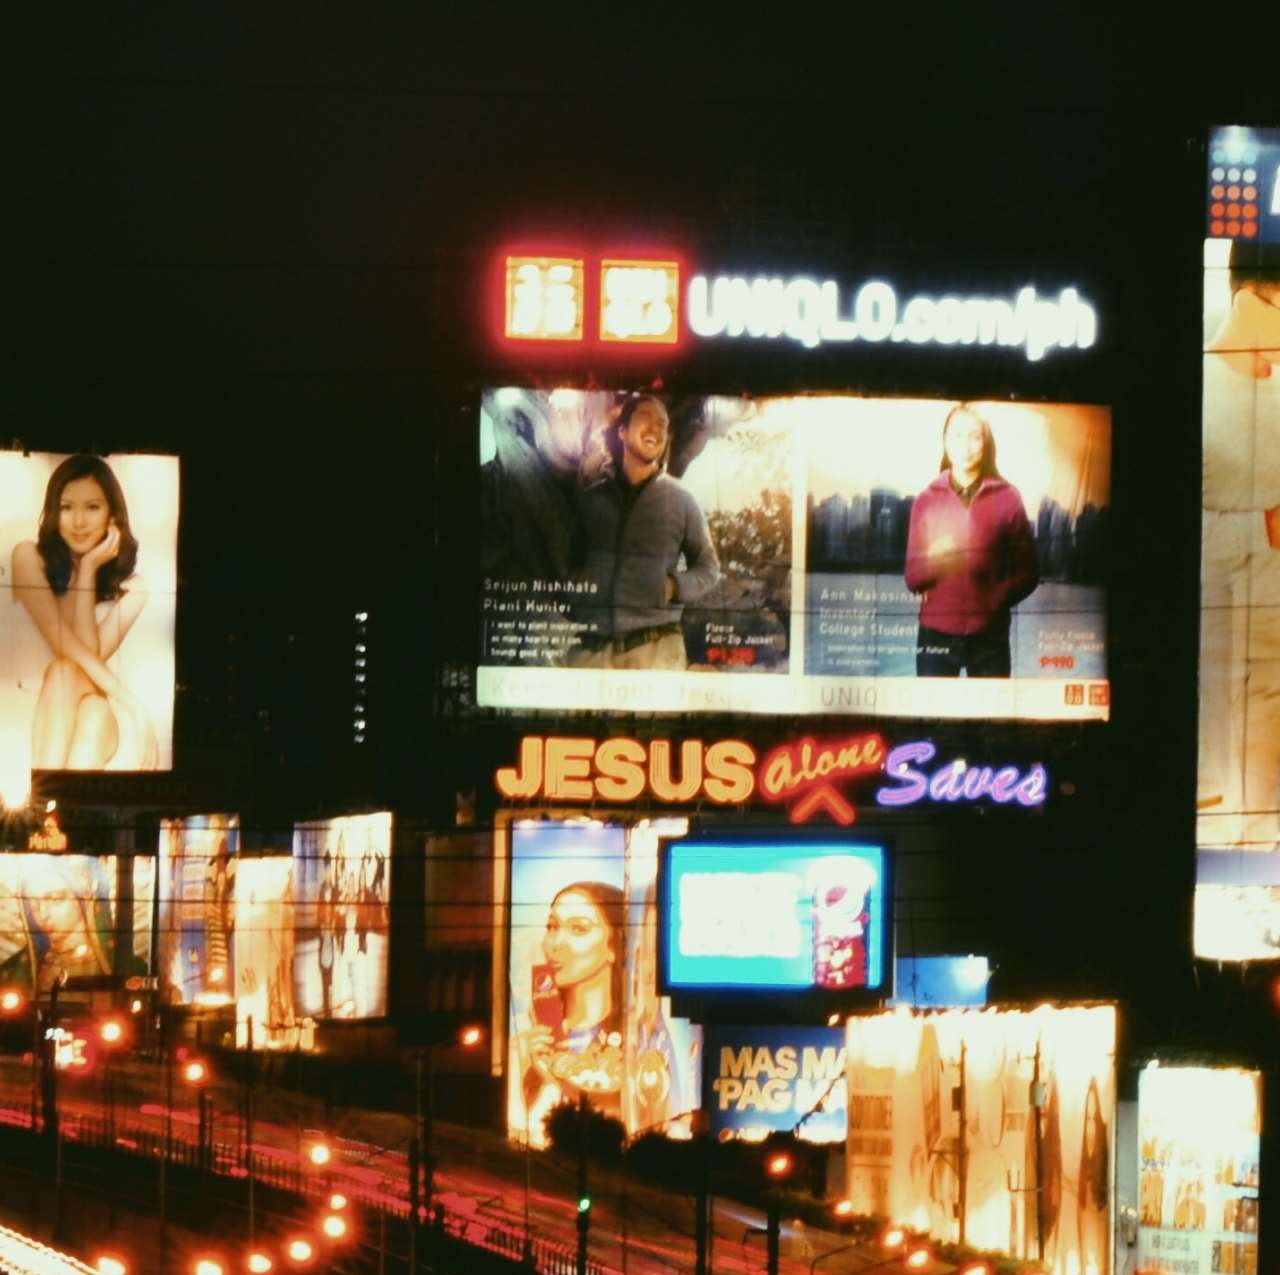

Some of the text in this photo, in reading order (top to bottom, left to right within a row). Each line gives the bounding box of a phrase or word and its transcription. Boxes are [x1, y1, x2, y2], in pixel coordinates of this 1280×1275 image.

[496, 736, 756, 801] JESUS
[876, 740, 1047, 806] Saves
[720, 1045, 799, 1080] MAS
